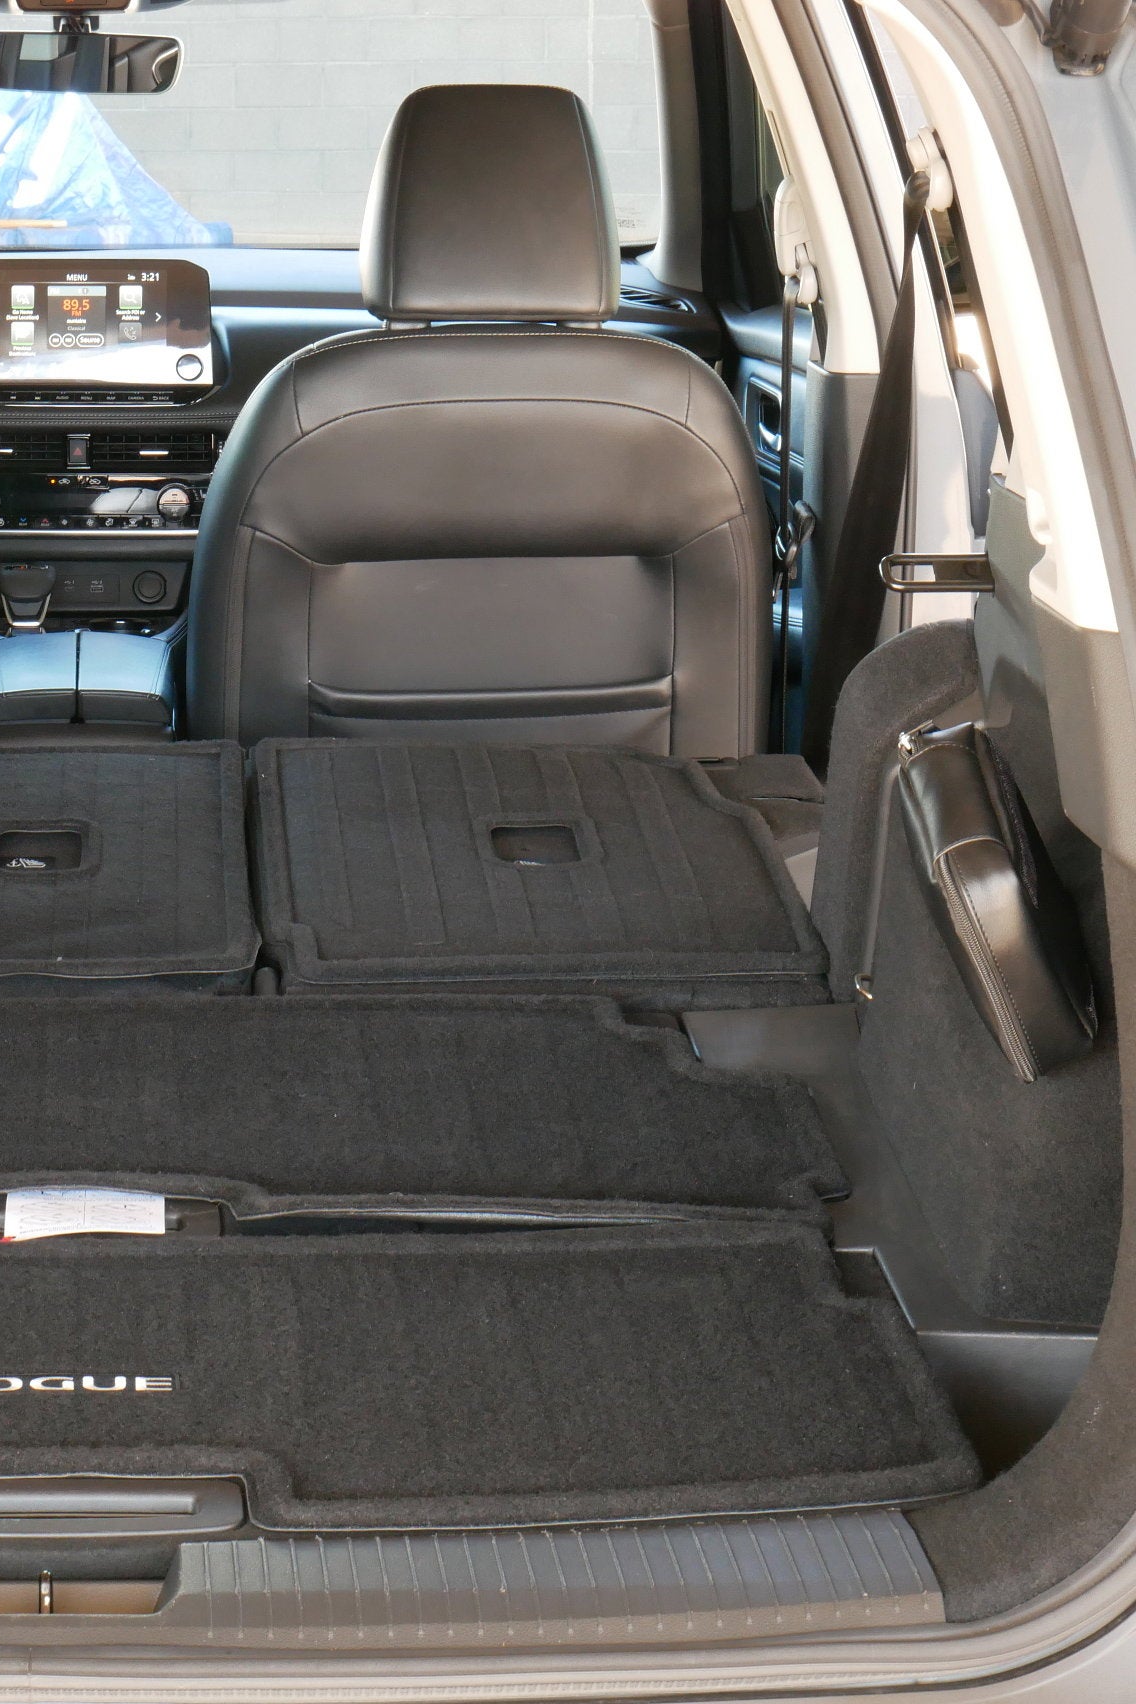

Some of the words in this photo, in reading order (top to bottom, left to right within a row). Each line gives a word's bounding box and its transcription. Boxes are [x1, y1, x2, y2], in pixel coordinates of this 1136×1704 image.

[66, 273, 88, 282] MENU
[141, 272, 160, 282] 3:21
[63, 299, 90, 311] 89.5
[79, 336, 101, 344] Source
